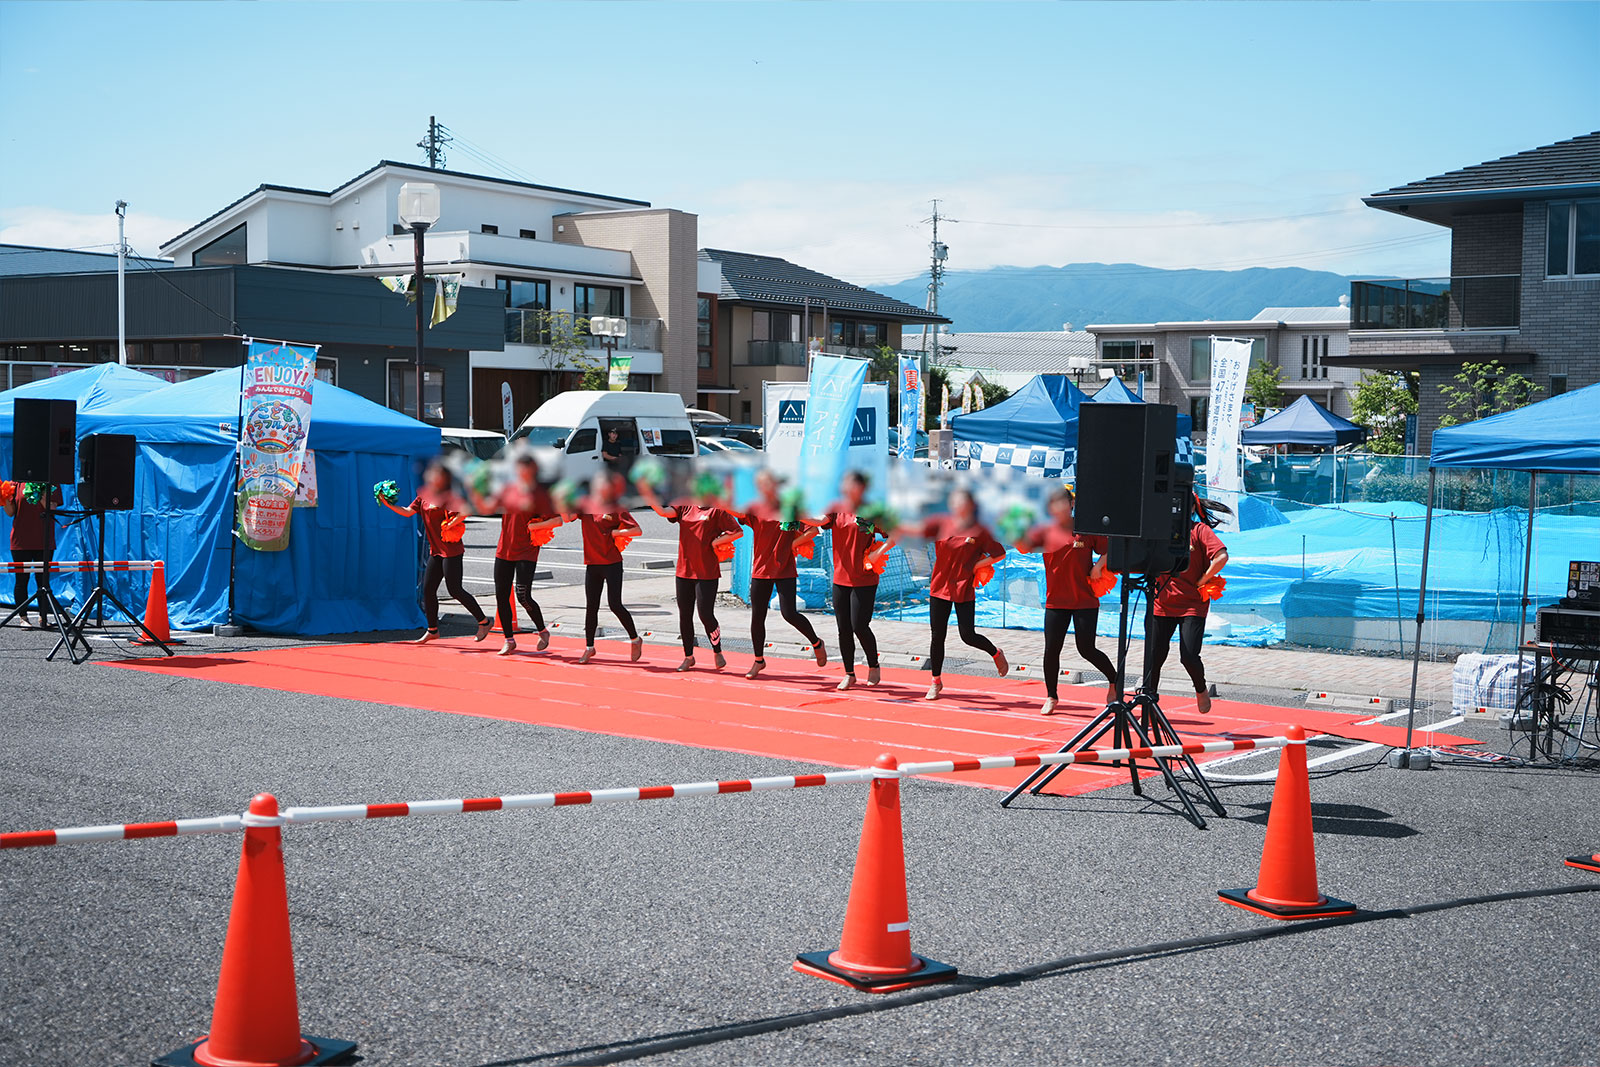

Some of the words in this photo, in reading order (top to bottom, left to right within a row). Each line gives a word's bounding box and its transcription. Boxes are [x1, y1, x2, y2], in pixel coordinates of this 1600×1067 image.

[254, 366, 310, 386] ENJOY!
[904, 369, 918, 391] 夏
[257, 406, 294, 422] こども
[783, 403, 804, 416] AI
